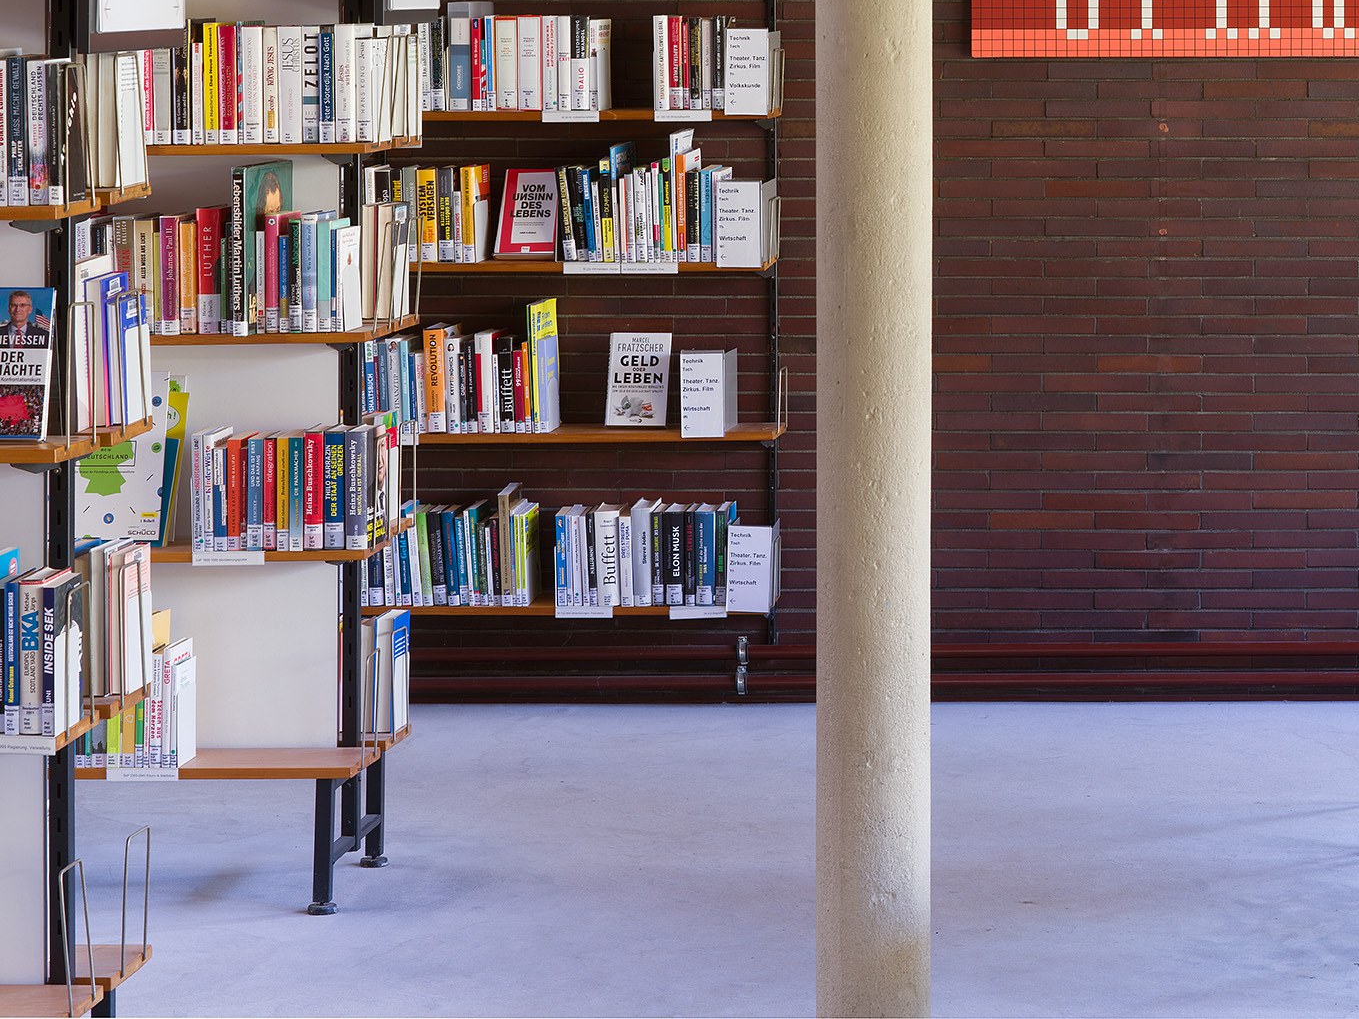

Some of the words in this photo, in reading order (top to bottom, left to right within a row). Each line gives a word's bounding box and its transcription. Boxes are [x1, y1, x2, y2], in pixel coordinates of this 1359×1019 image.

[266, 46, 274, 64] JESUS
[282, 38, 293, 71] JESUS
[291, 38, 300, 72] CHRISTUS
[304, 33, 318, 88] ZELOT
[323, 37, 331, 52] Gott
[266, 66, 274, 86] KÖNIG
[323, 53, 331, 70] Nach
[323, 72, 331, 104] Sloterdijk
[418, 185, 426, 217] SYSTEM
[427, 180, 435, 221] VERSAGEN
[522, 184, 546, 193] VOM
[233, 179, 242, 240] Lebensbilder
[510, 210, 551, 218] LEBENS
[521, 201, 542, 209] DES
[166, 235, 175, 249] Paul
[203, 226, 212, 276] LUTHER
[233, 240, 242, 274] Martin
[292, 225, 300, 265] Mohamed
[166, 251, 175, 280] Johannes
[233, 275, 242, 311] Luthers
[1, 351, 24, 363] DER
[430, 334, 438, 386] REVOLUTION
[617, 343, 664, 352] FRATZSCHER
[620, 355, 659, 366] GELD
[500, 368, 513, 412] Buffett
[516, 379, 521, 387] 99
[614, 373, 663, 383] LEBEN
[266, 442, 274, 482] Integration
[306, 439, 314, 491] Buschkowsky
[331, 470, 337, 480] AN
[349, 440, 357, 492] Buschkowsky
[672, 526, 680, 551] MUSK
[601, 535, 616, 585] Buffett
[672, 553, 680, 577] ELON
[21, 611, 39, 651] BKA
[45, 607, 54, 632] SEK
[45, 633, 54, 674] INSIDE
